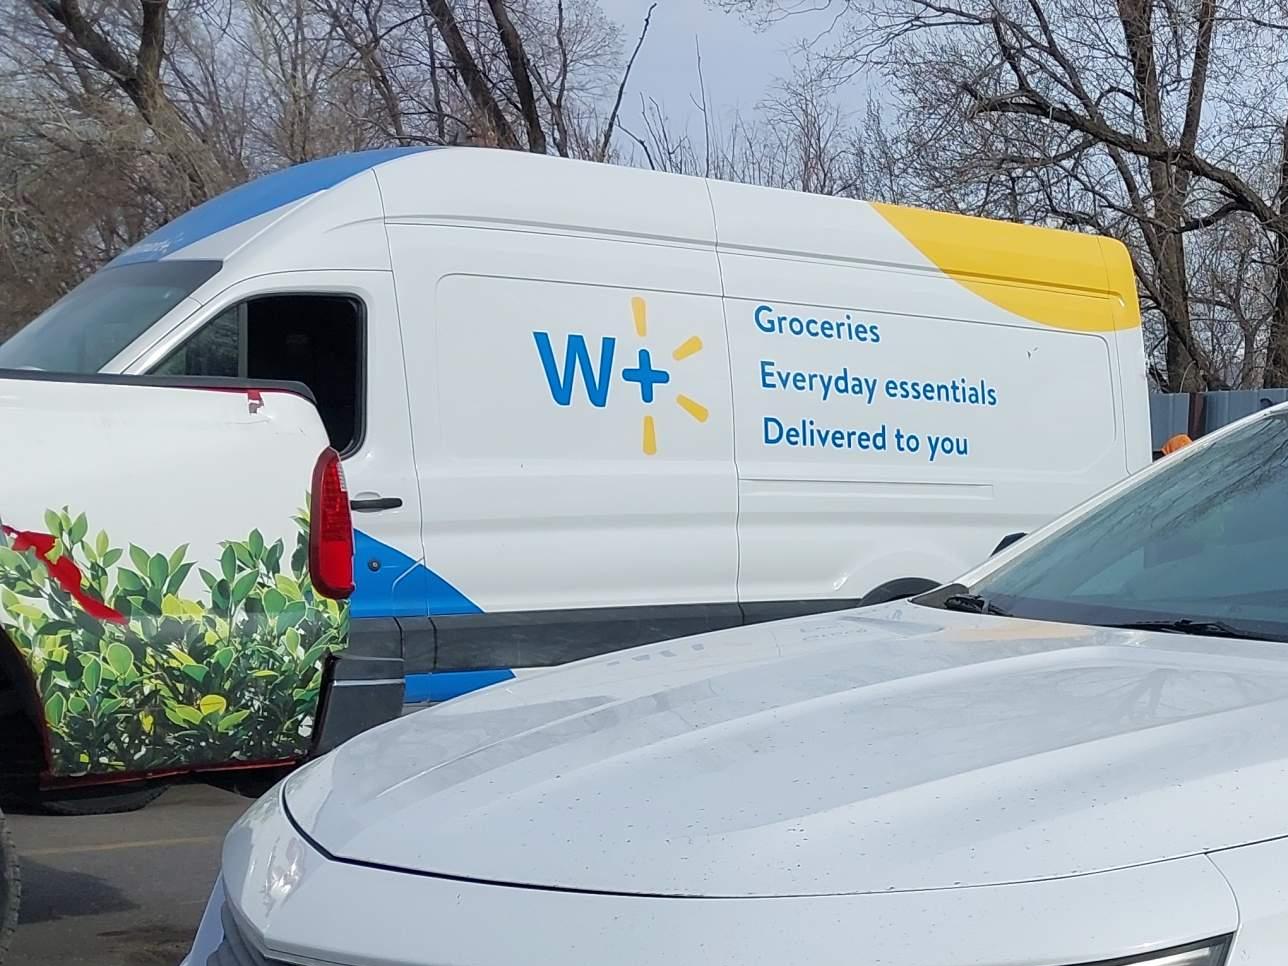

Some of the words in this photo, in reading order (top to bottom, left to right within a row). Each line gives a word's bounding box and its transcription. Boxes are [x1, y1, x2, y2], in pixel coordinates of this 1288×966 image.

[753, 304, 881, 344] Groceries
[759, 360, 877, 403] Everyday
[884, 379, 997, 406] essentials
[763, 416, 887, 452] Delivered
[895, 426, 921, 455] to
[927, 435, 969, 460] you
